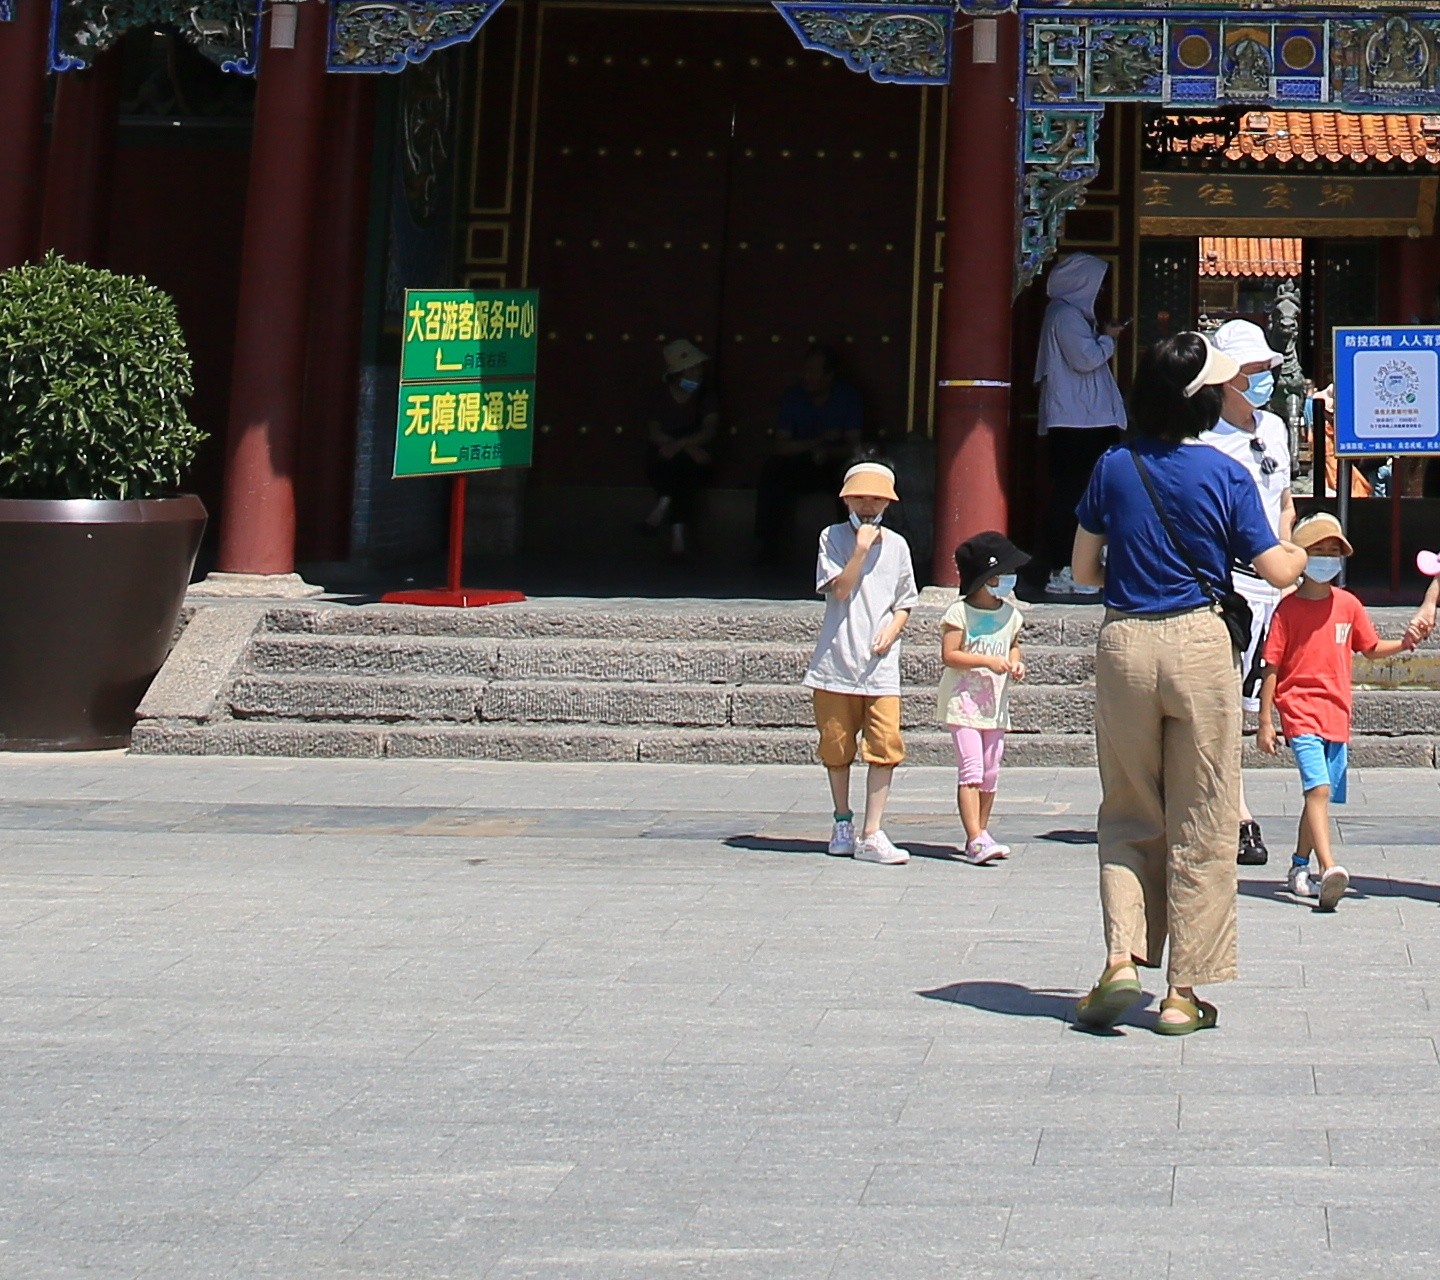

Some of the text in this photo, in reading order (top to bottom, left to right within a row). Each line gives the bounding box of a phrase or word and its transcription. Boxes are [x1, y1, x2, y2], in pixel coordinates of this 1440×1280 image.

[407, 299, 535, 343] 大召游客服务中心
[1344, 335, 1392, 348] 防控疫情
[464, 352, 508, 369] 向西右拐
[404, 389, 529, 437] 无障碍通道
[460, 443, 503, 461] 向西右拐
